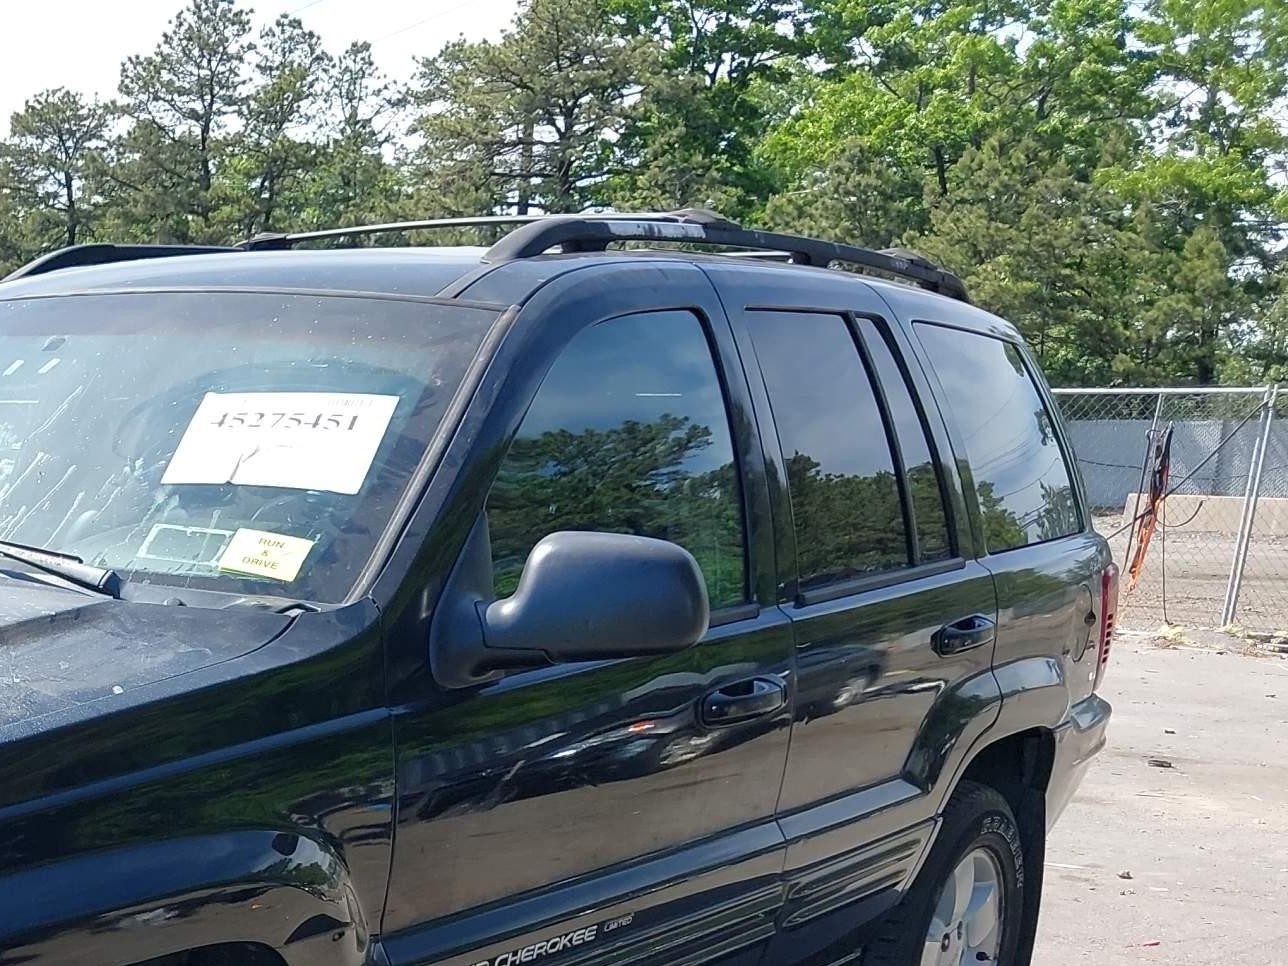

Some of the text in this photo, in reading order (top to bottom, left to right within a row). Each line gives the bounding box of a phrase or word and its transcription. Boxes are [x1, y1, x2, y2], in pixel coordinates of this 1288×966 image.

[211, 412, 358, 431] 45275451
[258, 537, 285, 549] RUN
[241, 556, 280, 570] DRIVE
